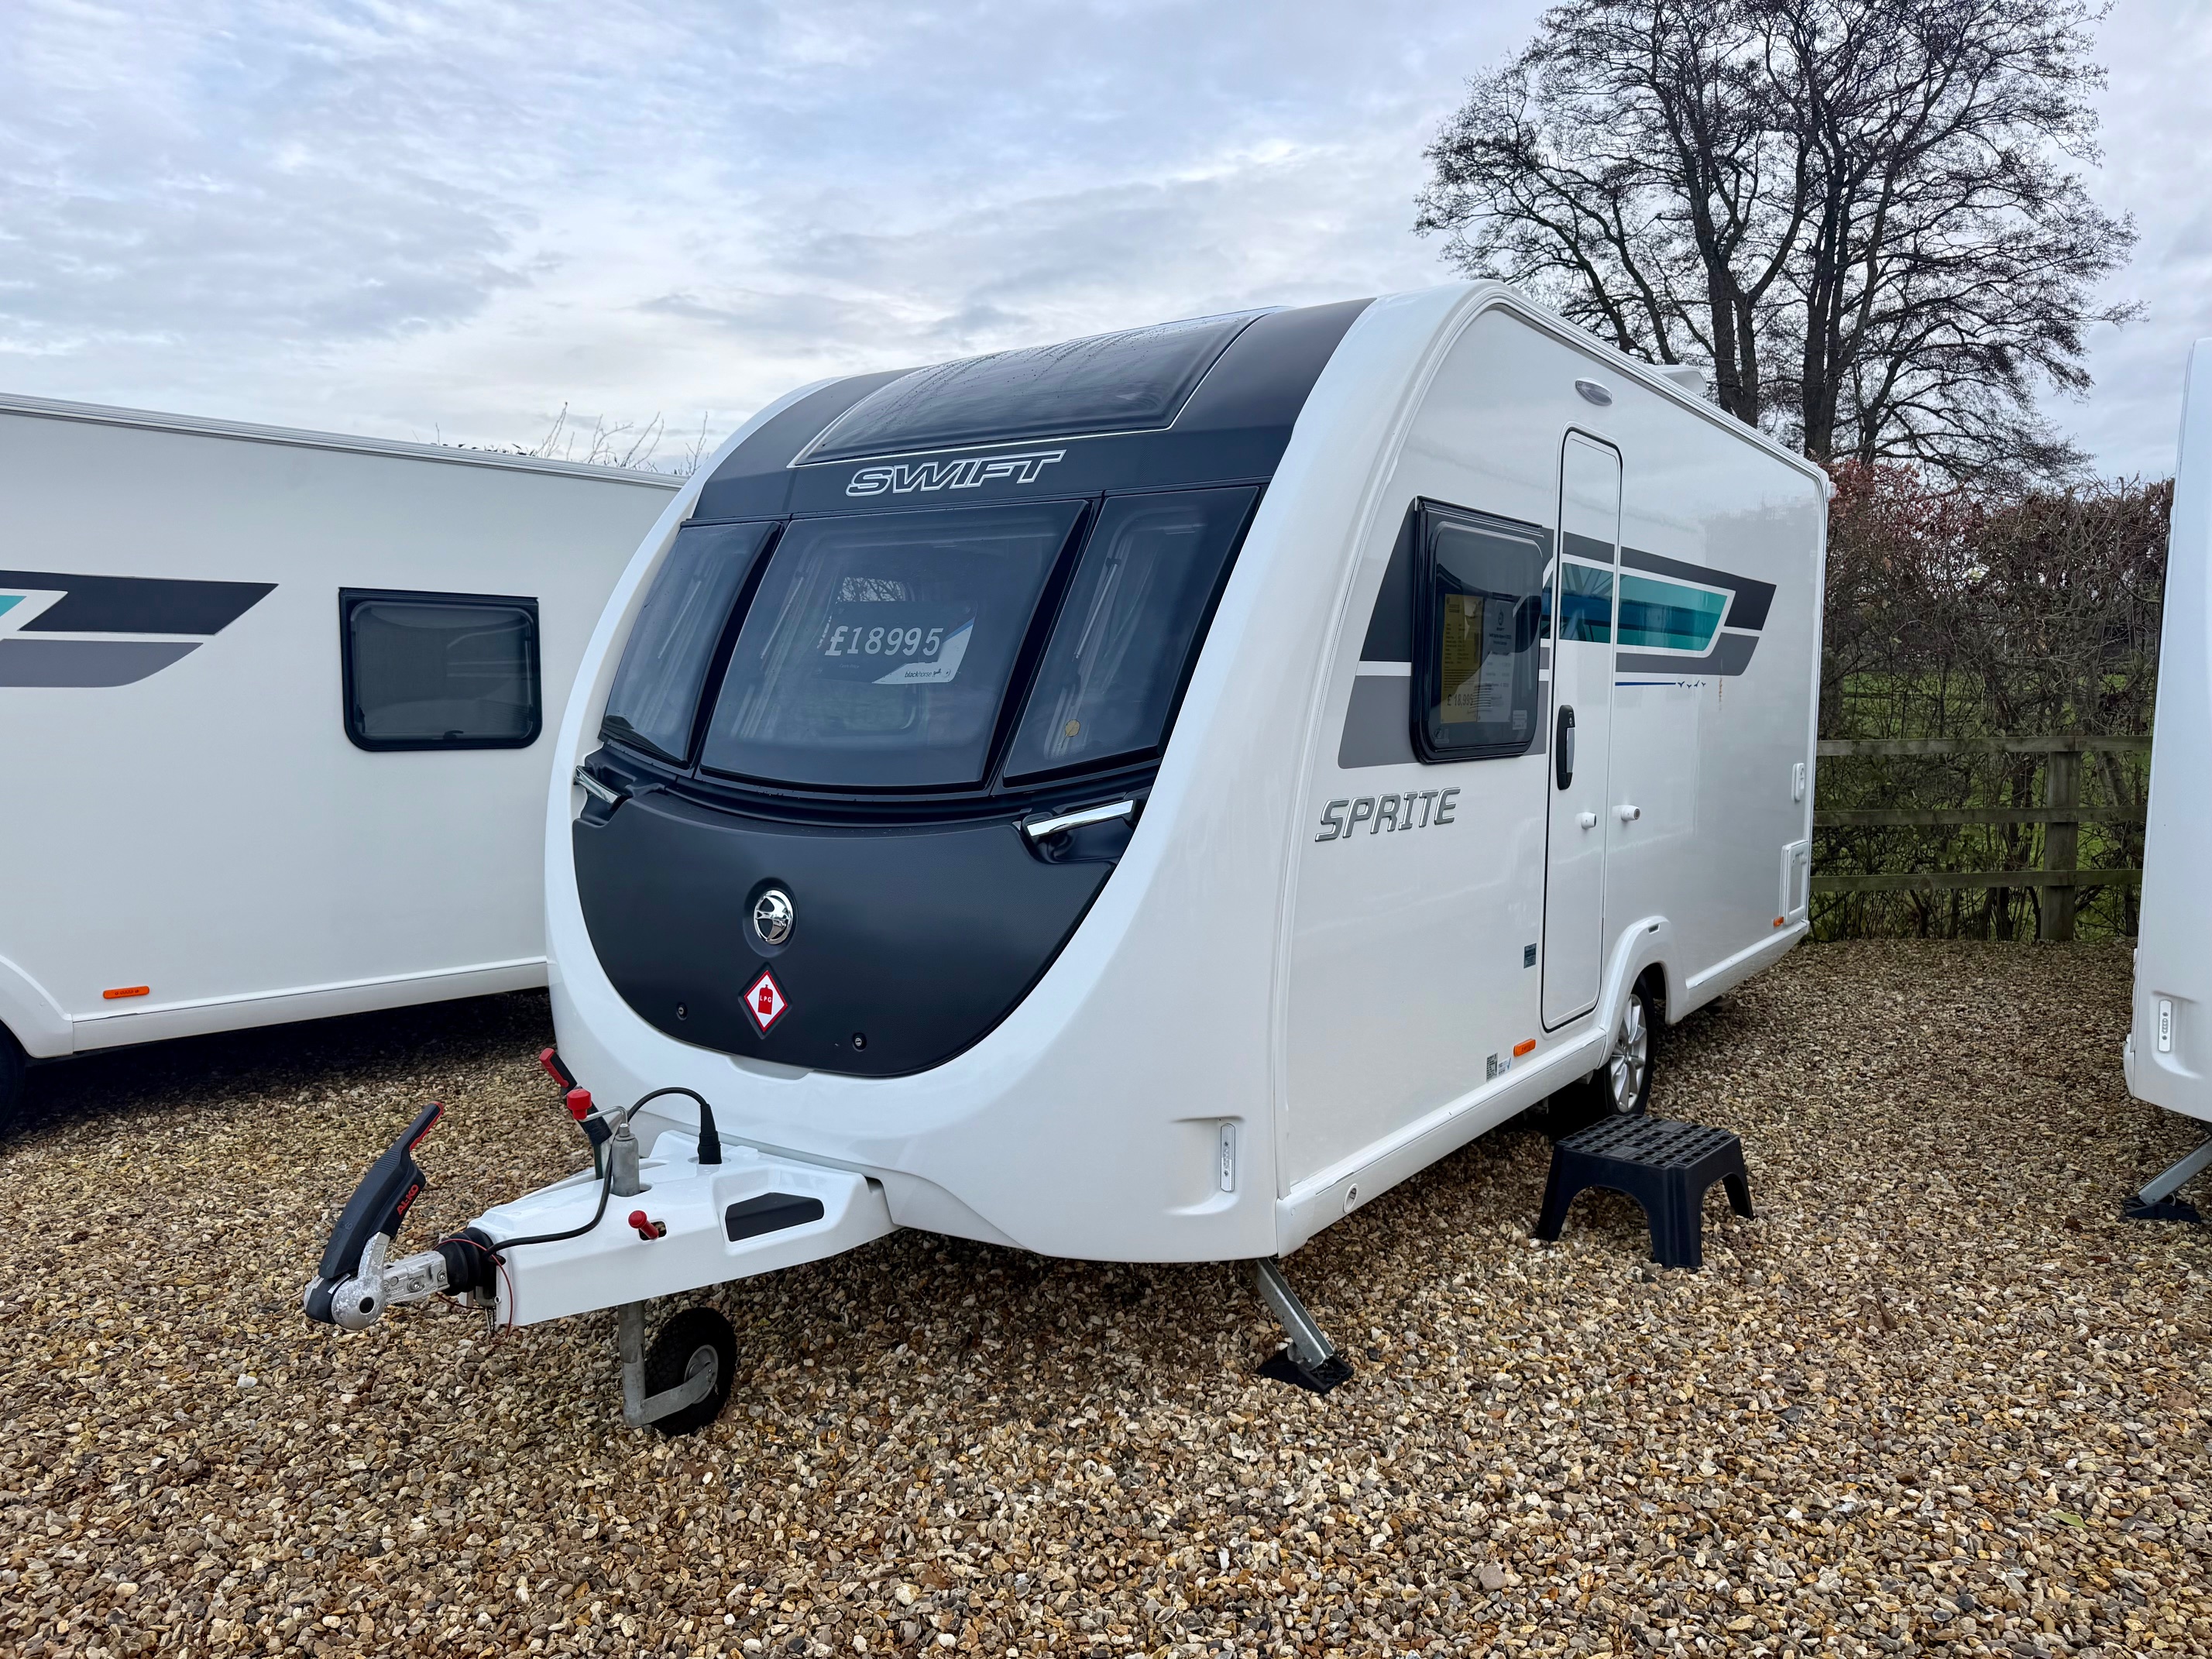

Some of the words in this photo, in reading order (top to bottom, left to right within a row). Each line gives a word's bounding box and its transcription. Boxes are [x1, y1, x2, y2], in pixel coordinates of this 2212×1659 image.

[846, 449, 1066, 496] SWIFT
[825, 626, 943, 656] £18995
[1315, 787, 1461, 842] SPRITE
